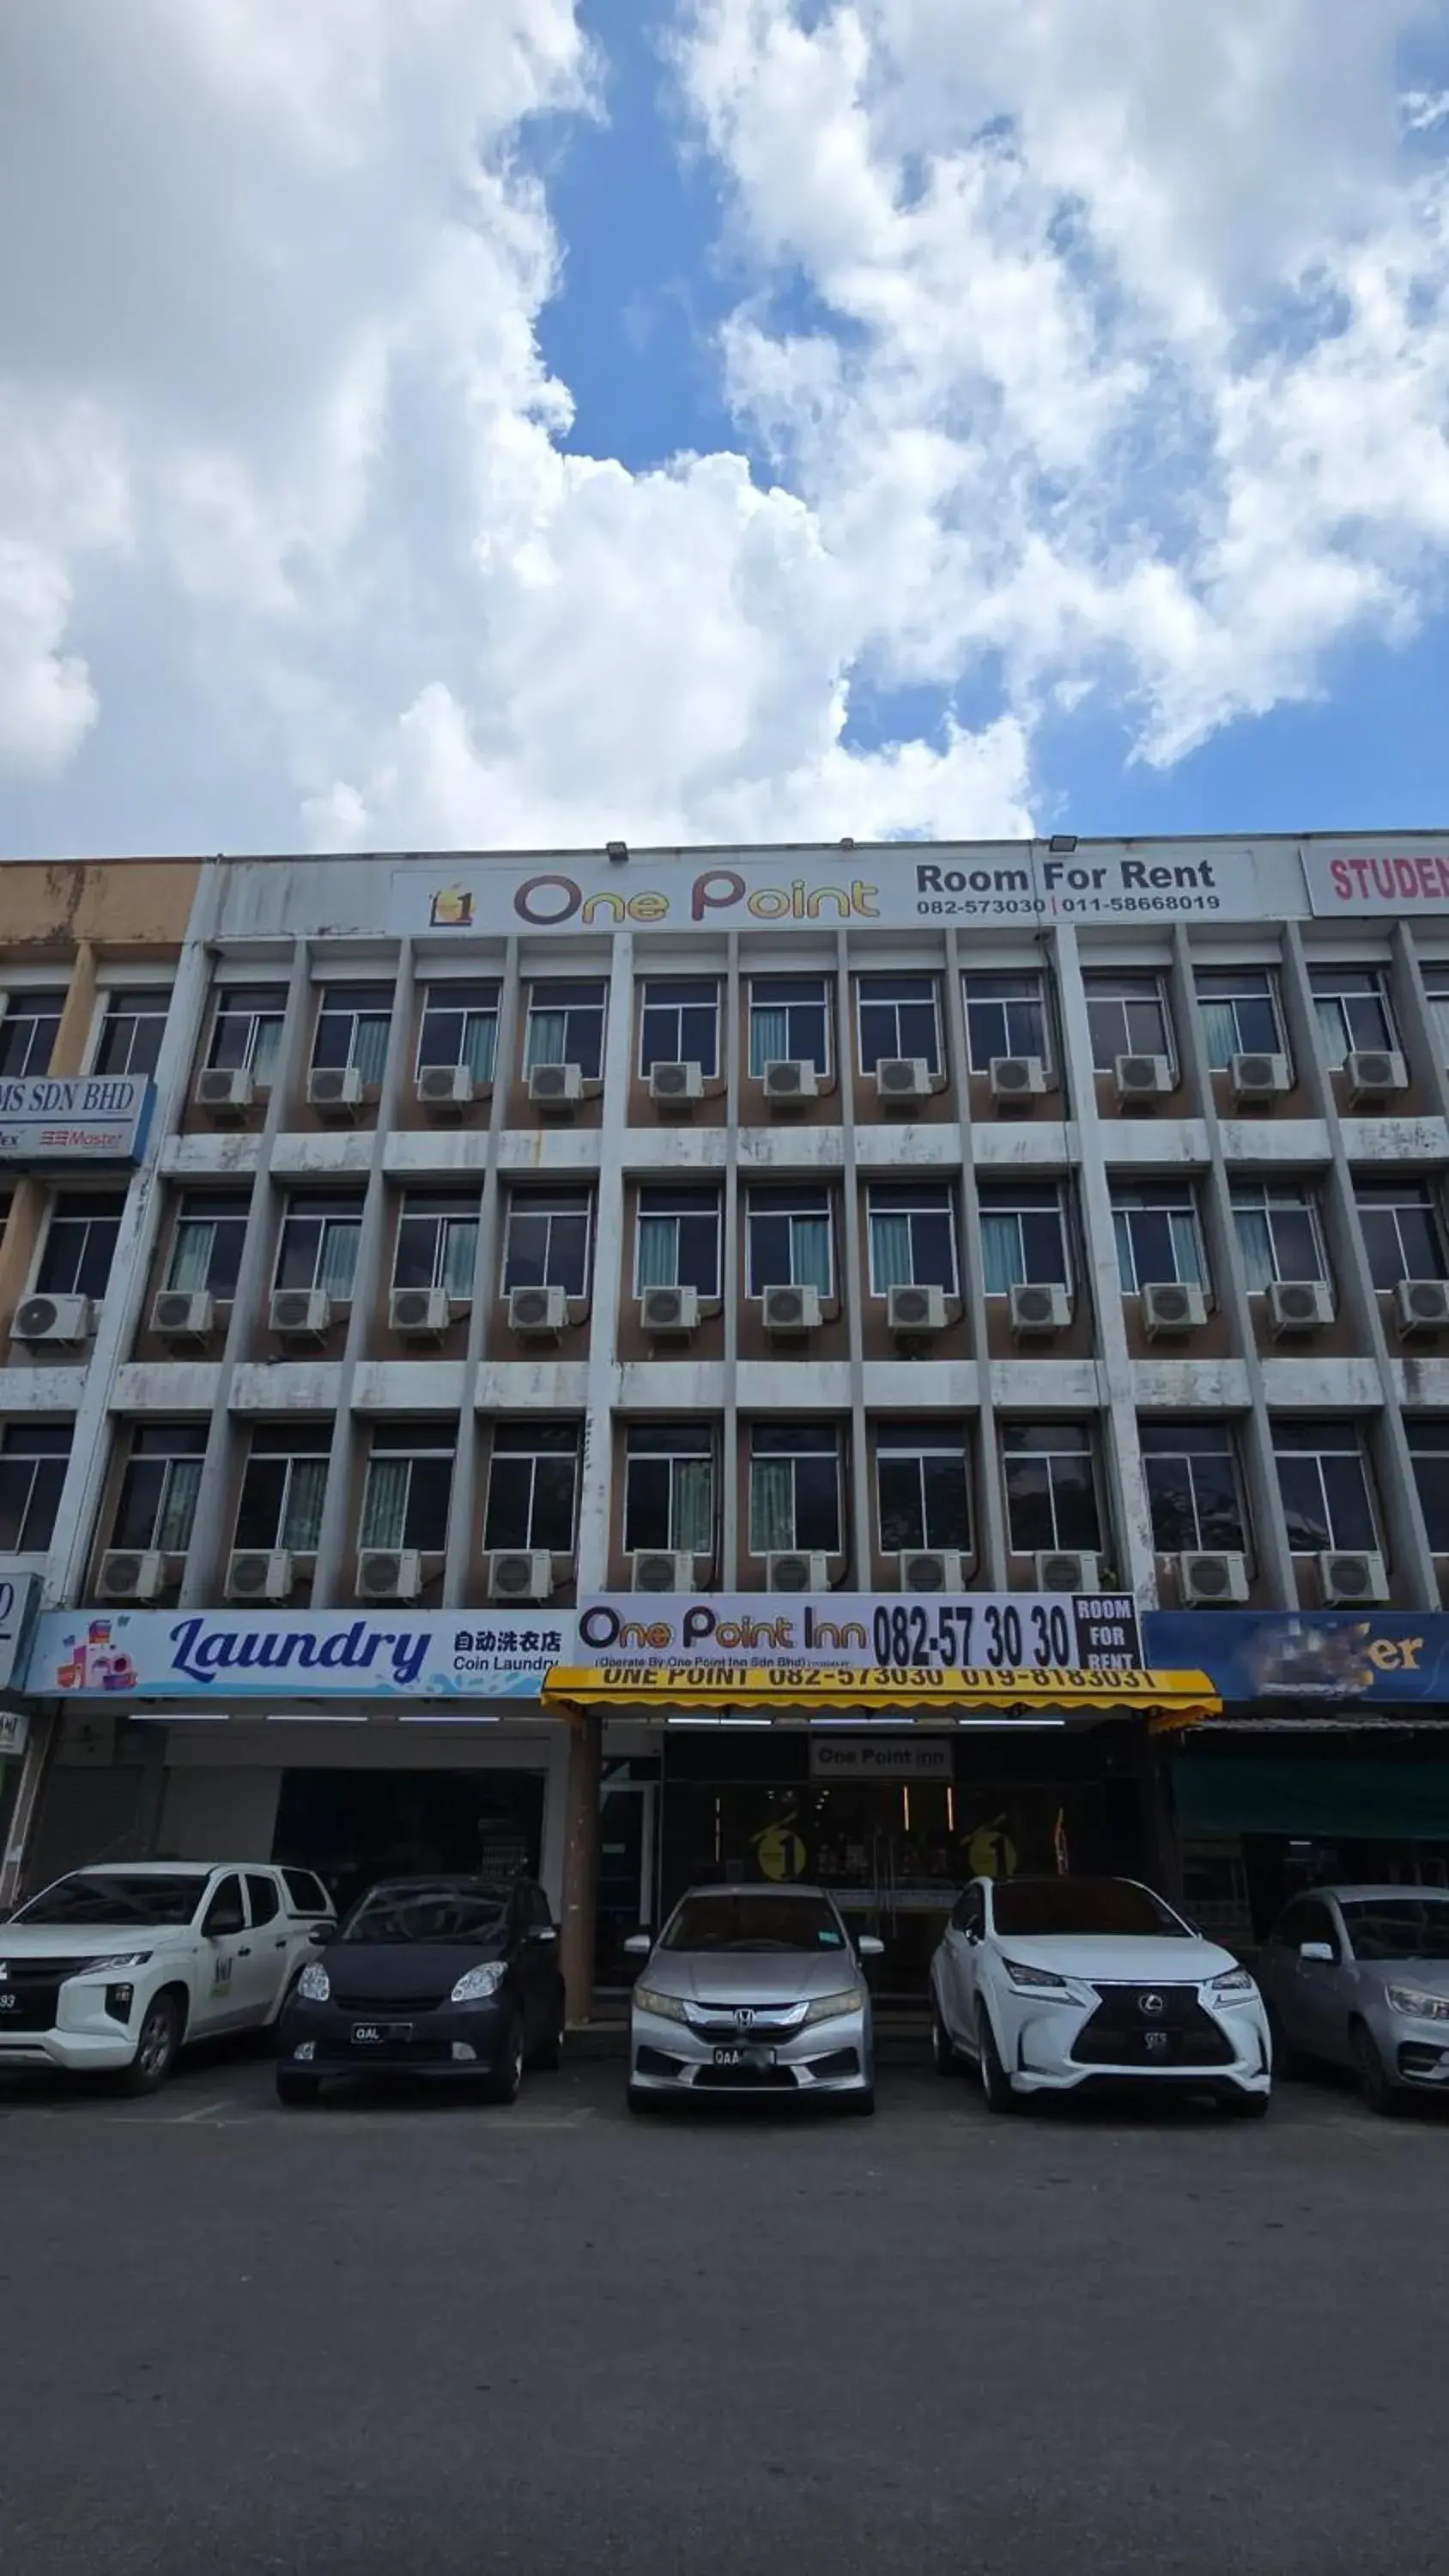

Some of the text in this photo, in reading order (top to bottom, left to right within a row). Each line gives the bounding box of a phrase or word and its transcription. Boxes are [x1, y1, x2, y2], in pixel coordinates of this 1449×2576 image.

[917, 860, 1216, 892] Room For Rent
[513, 870, 880, 925] One Point
[917, 896, 1220, 914] 082-573030 011-58668019
[28, 1084, 79, 1111] SDN
[82, 1083, 134, 1110] BHD
[1076, 1600, 1131, 1619] ROOM
[579, 1606, 867, 1649] One Point Inn
[874, 1606, 1069, 1667] 082-57 30 30
[1090, 1626, 1125, 1645] FOR
[170, 1618, 433, 1684] Laundry
[454, 1631, 561, 1652] 自动洗衣店
[454, 1656, 488, 1670] Coin
[603, 1669, 658, 1684] ONE
[668, 1669, 745, 1685] POINT
